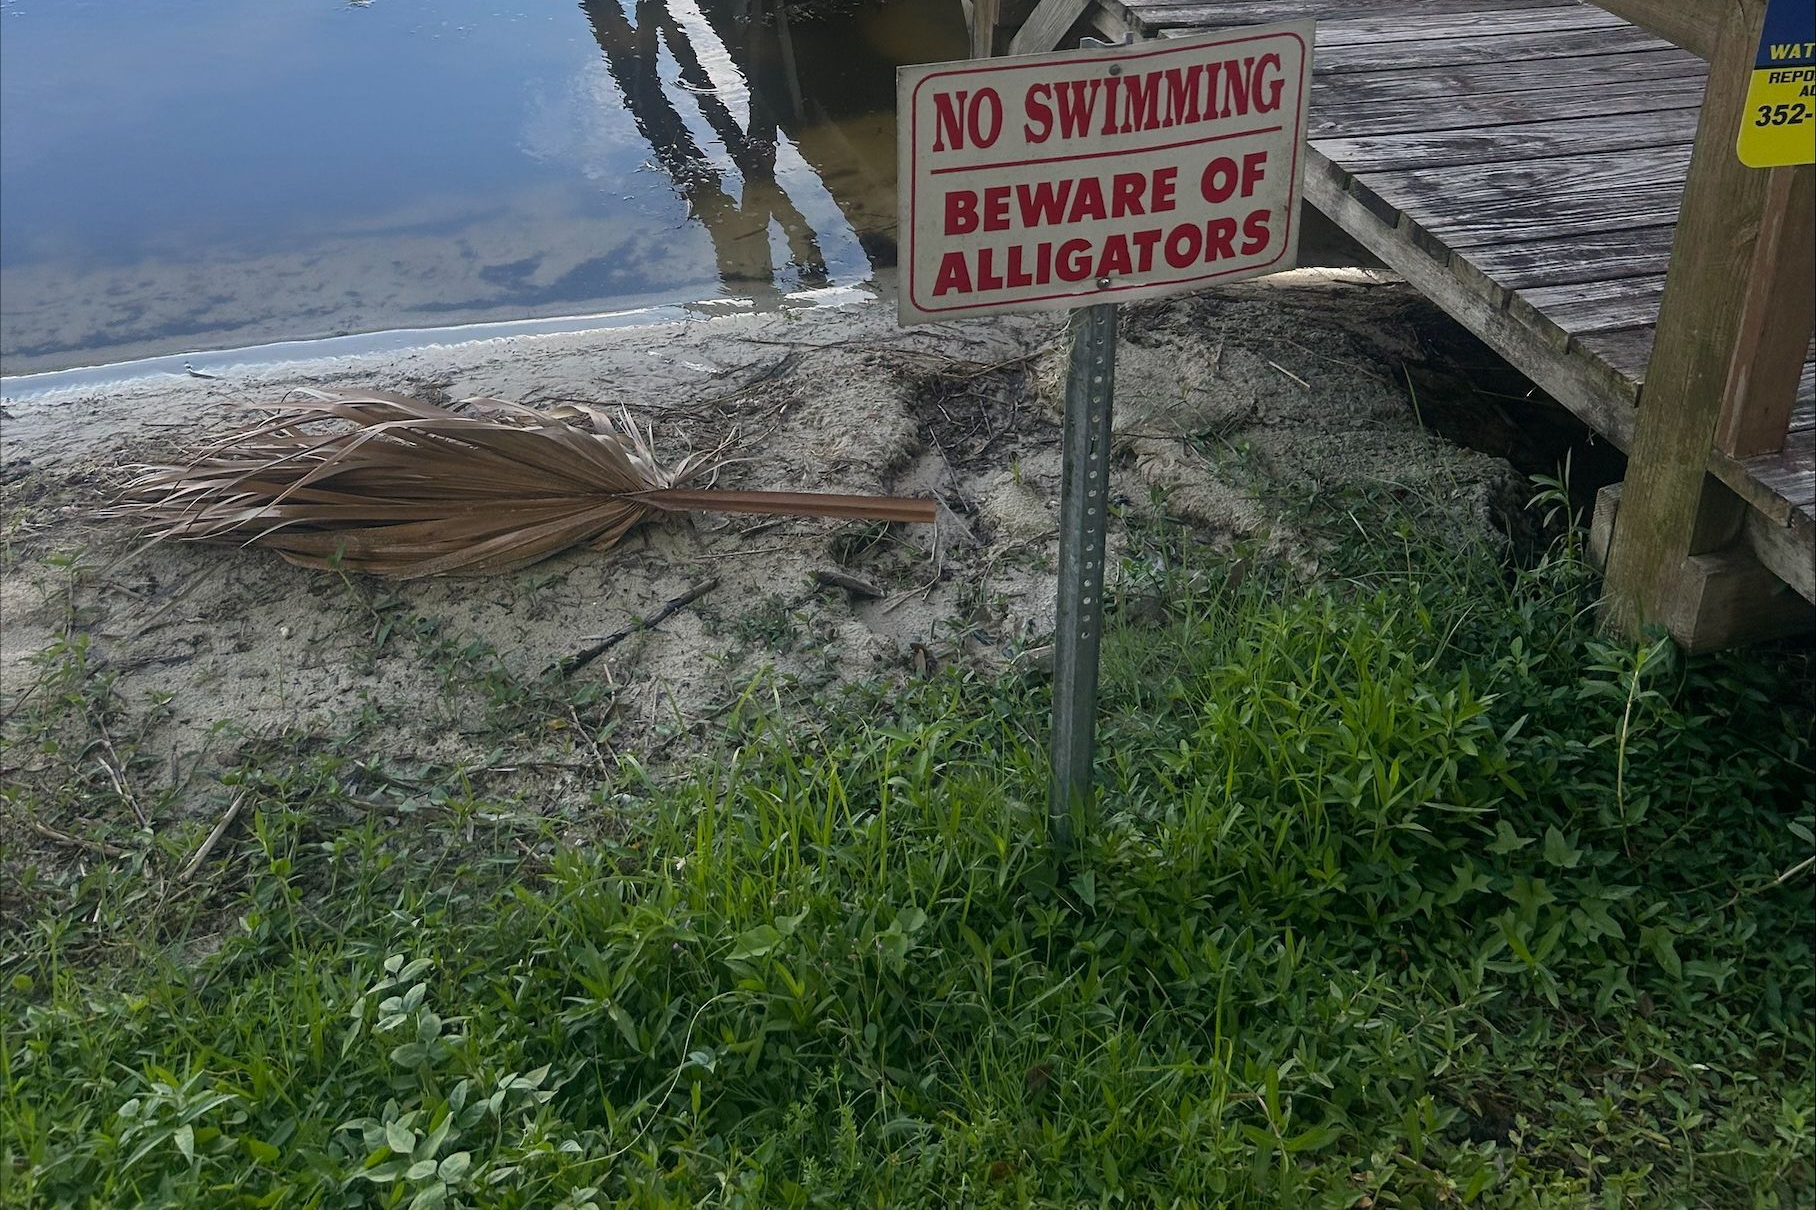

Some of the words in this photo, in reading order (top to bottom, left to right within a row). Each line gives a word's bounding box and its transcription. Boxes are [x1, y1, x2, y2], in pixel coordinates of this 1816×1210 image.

[932, 87, 1003, 153] NO
[1024, 53, 1285, 144] SWIMMING
[944, 166, 1178, 236] BEWARE
[1200, 151, 1268, 204] OF
[932, 209, 1271, 297] ALLIGATORS
